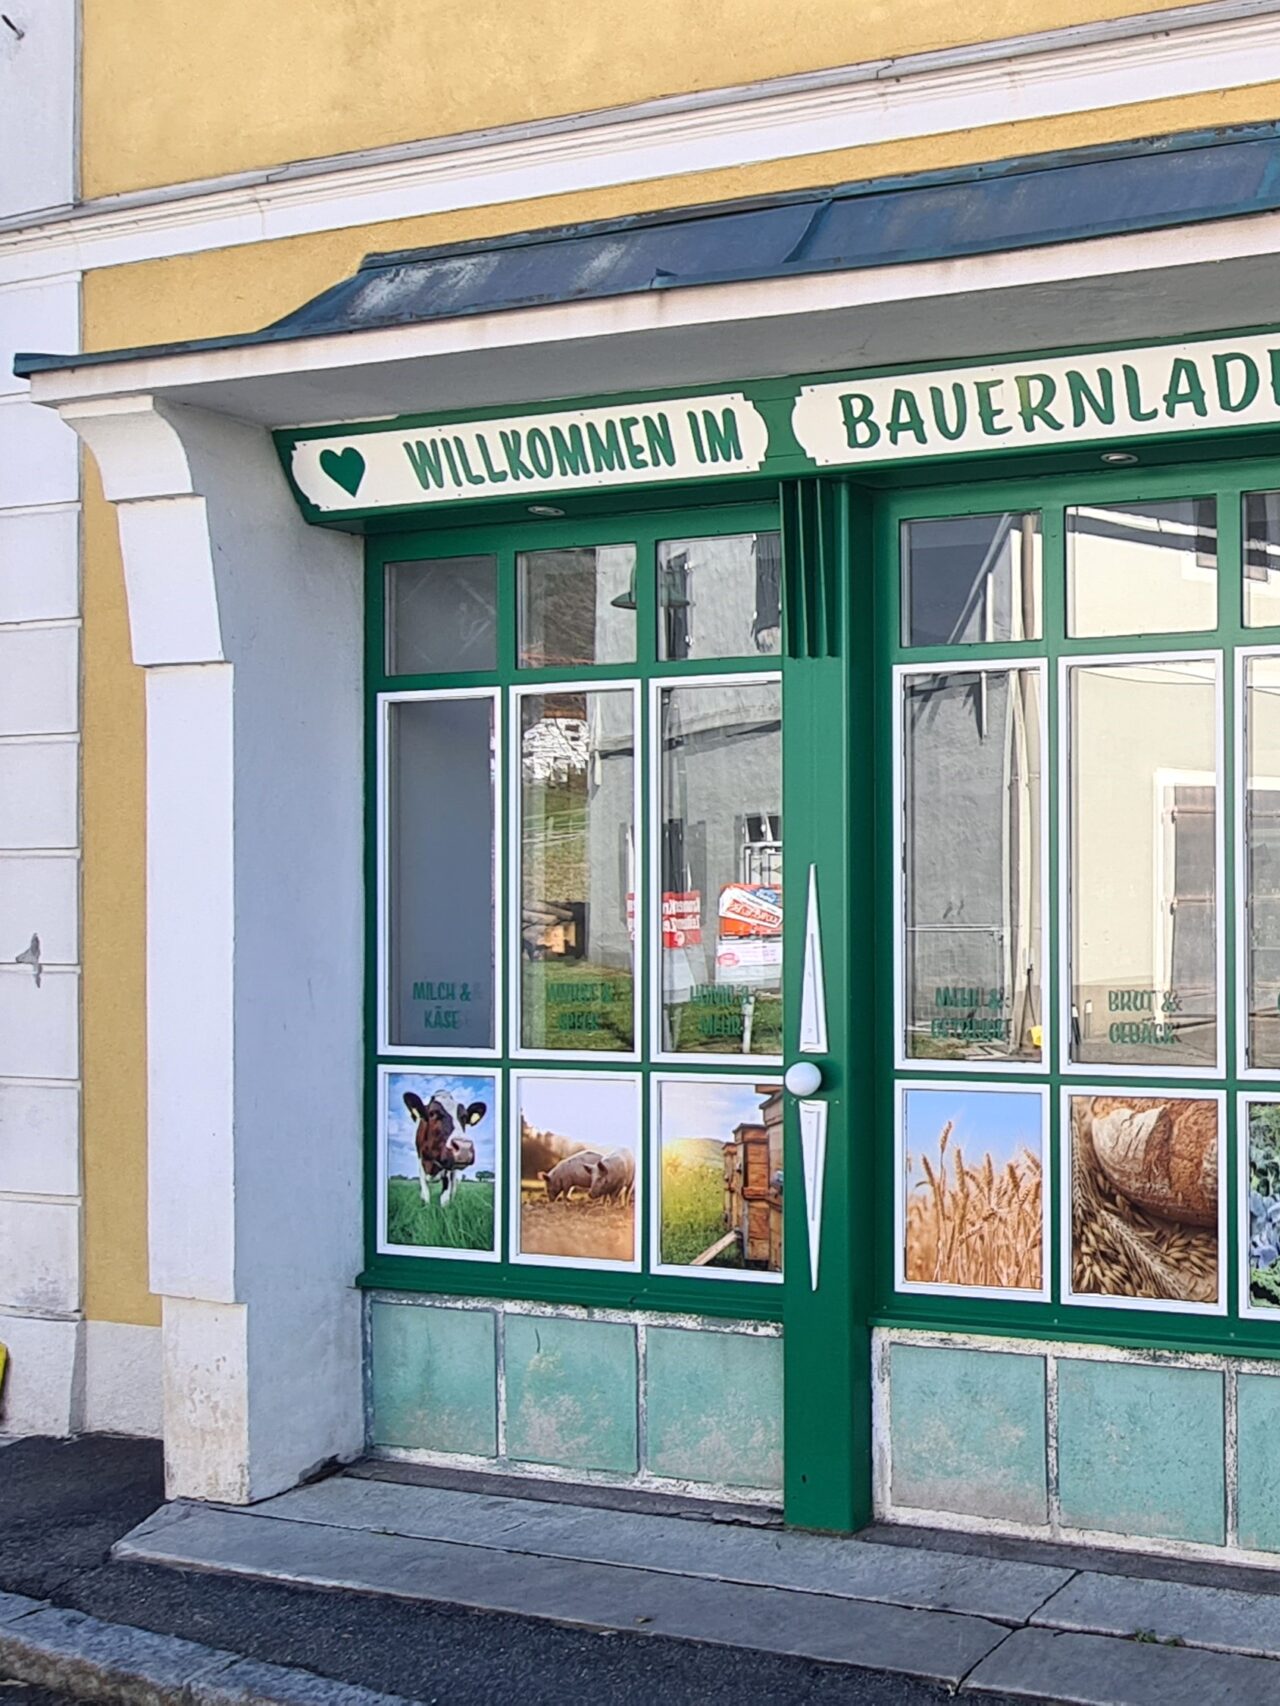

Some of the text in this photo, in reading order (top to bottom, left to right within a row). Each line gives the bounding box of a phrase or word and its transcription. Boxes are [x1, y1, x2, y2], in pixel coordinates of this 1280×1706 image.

[402, 407, 744, 490] WILLKOMMEN IM
[412, 981, 471, 1001] MILCH &
[1108, 990, 1180, 1012] BROT &
[424, 1006, 461, 1029] KÄSE
